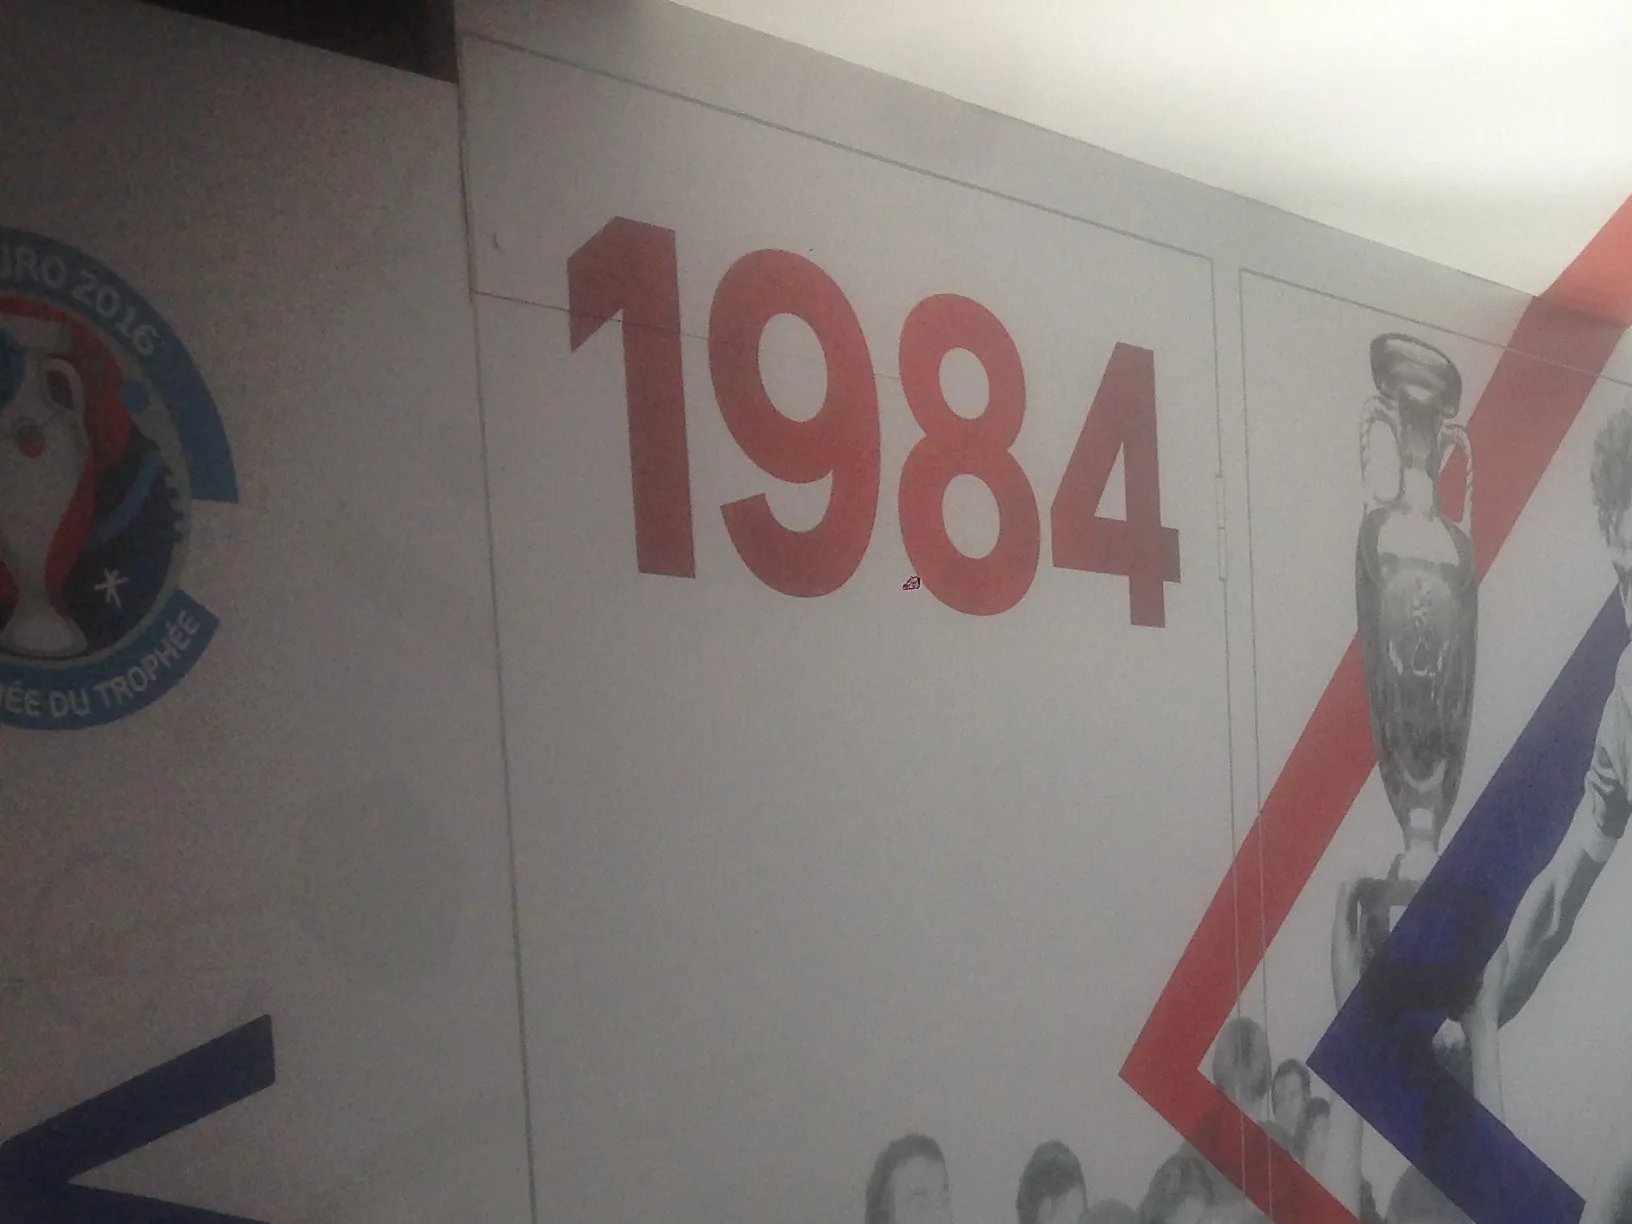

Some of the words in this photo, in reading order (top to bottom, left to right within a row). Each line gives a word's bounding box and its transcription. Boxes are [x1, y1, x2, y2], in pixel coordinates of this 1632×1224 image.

[71, 268, 159, 357] 2016
[566, 215, 1182, 629] 1984
[49, 688, 91, 719] DU
[93, 608, 201, 709] TROPHÉE
